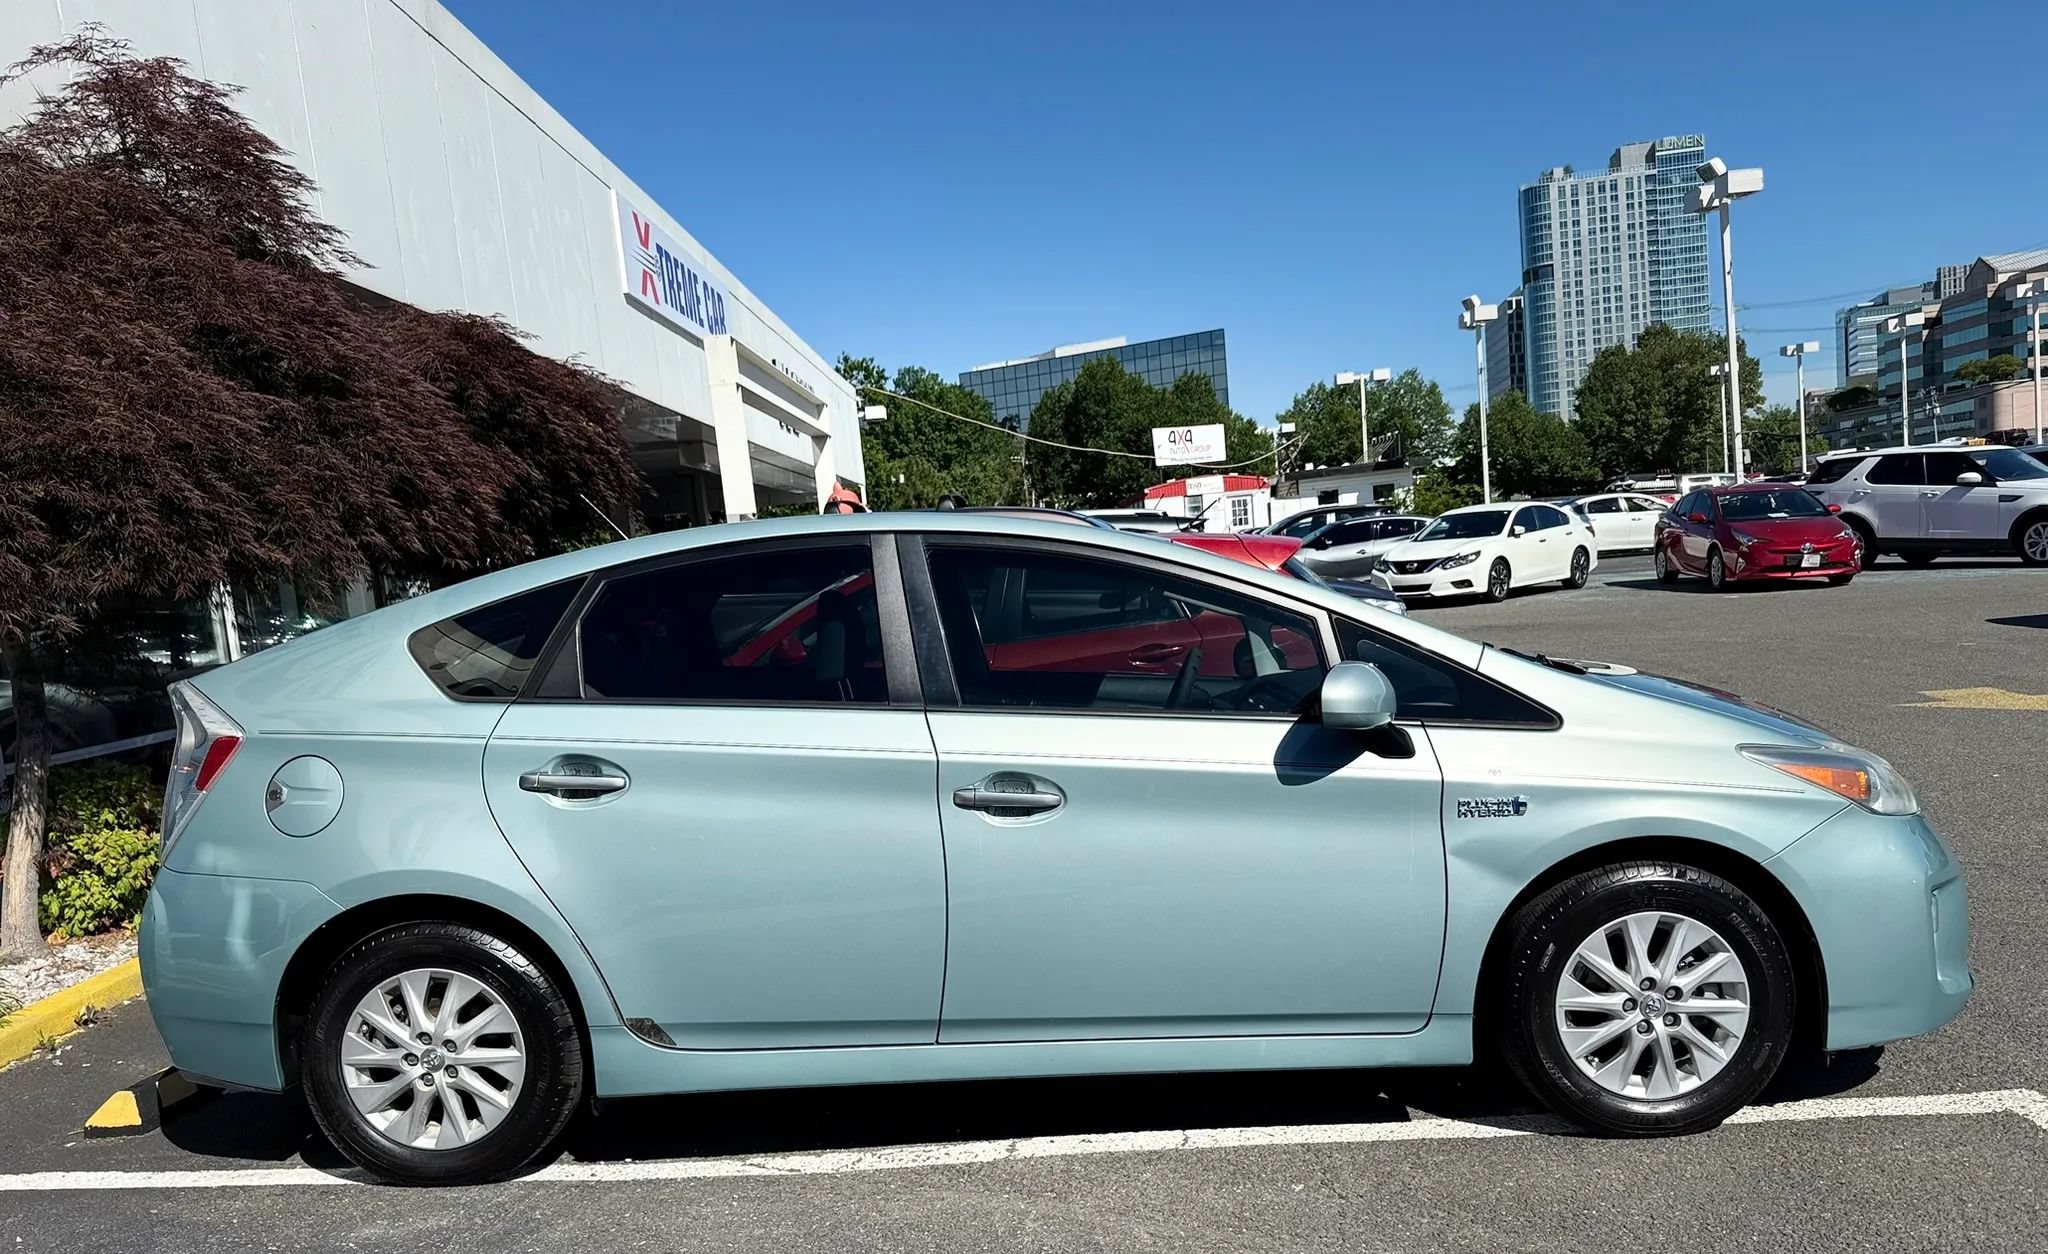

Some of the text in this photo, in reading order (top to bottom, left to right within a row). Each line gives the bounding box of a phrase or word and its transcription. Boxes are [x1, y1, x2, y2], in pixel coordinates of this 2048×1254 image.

[1656, 134, 1704, 150] LUMEN
[703, 280, 727, 335] CAR
[1458, 809, 1512, 818] HYBRID
